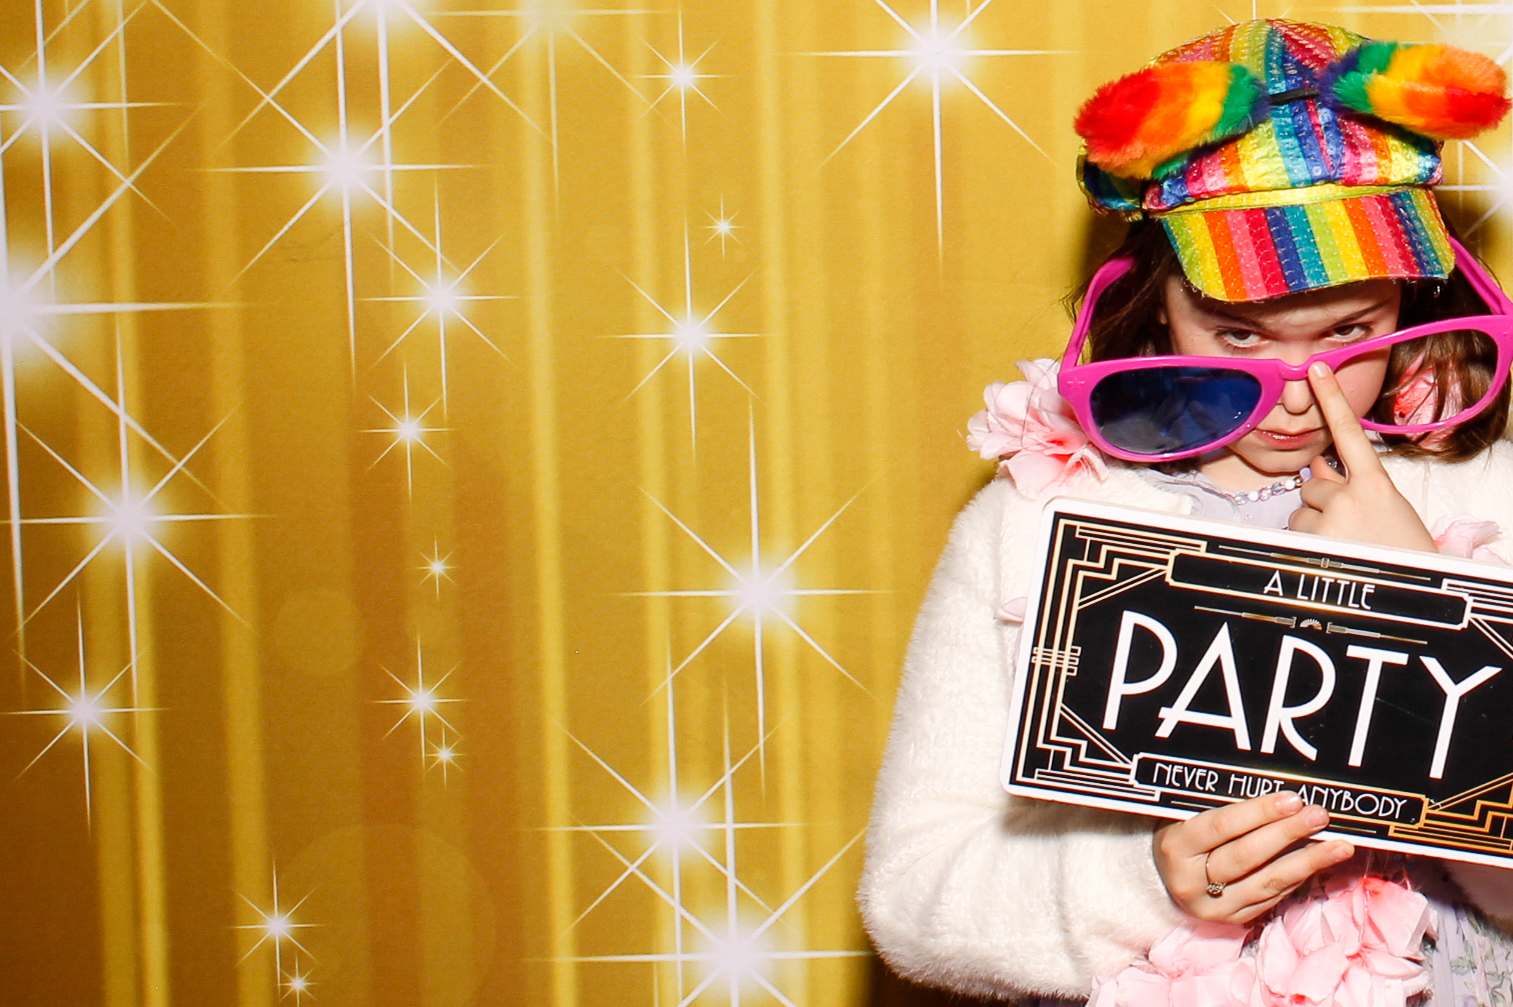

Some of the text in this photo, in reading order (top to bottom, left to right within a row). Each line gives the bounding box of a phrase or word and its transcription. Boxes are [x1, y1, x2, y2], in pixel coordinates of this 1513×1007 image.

[1263, 569, 1376, 610] A LITTLE
[1102, 609, 1503, 780] PARTY
[1152, 762, 1219, 793] NEVER
[1296, 784, 1408, 820] ANYBODY
